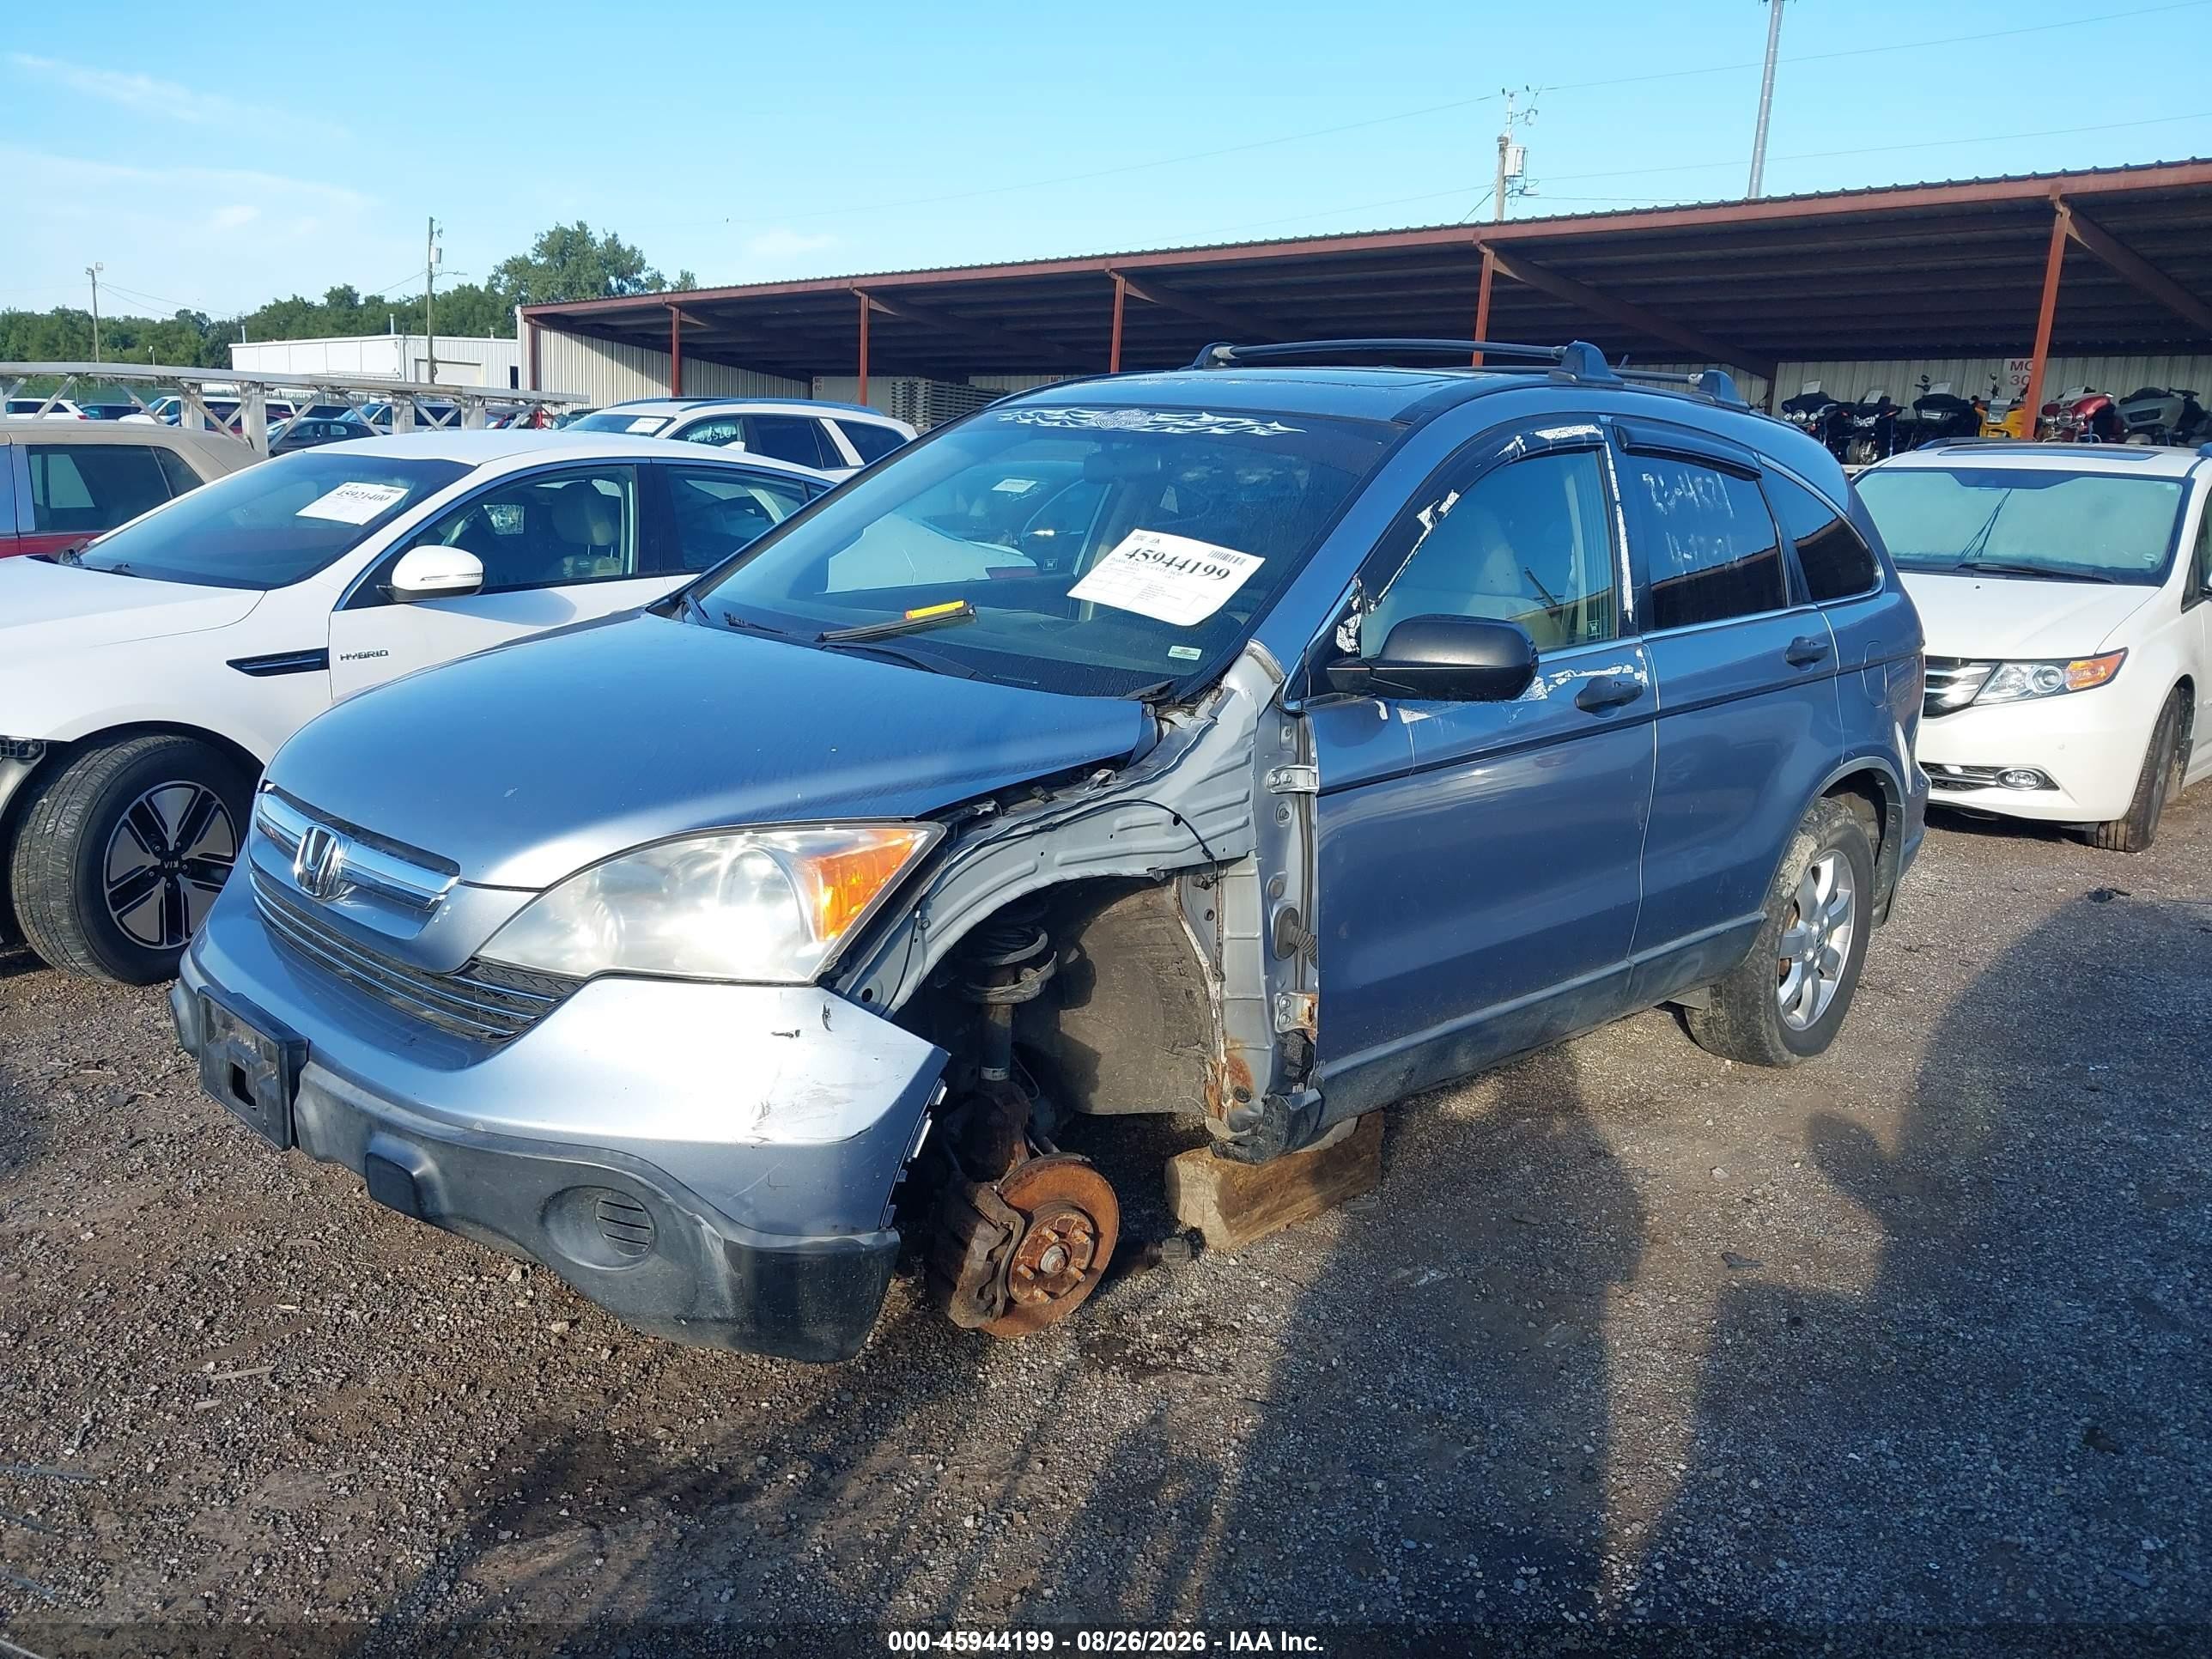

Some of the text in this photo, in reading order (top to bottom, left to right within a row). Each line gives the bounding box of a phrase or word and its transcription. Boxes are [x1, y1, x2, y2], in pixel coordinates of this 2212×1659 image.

[2010, 361, 2033, 371] MC
[2010, 374, 2031, 386] 30
[1125, 548, 1231, 580] 45944199
[339, 649, 389, 661] HYBRID
[163, 860, 179, 869] KIA
